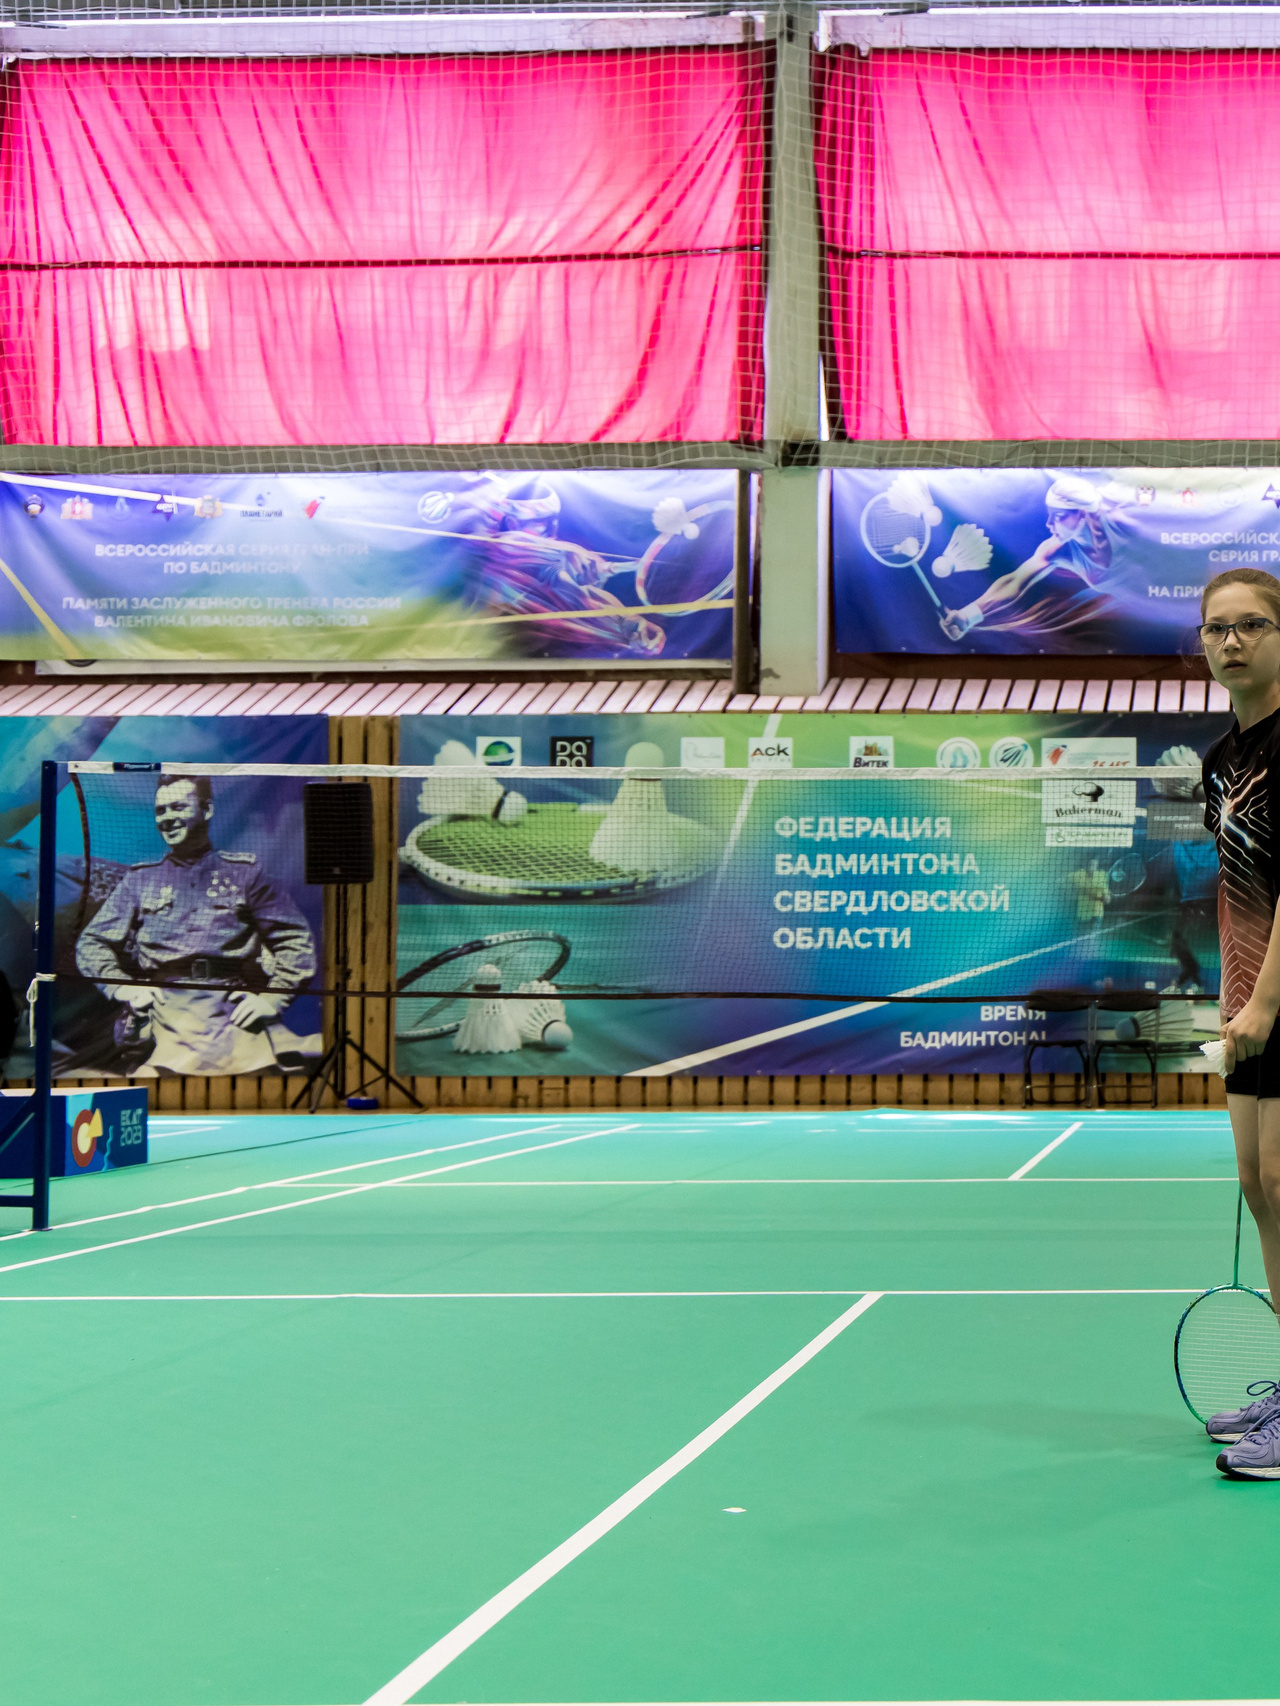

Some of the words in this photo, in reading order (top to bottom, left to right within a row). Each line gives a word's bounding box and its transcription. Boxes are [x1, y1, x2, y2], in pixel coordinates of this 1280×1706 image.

[94, 541, 236, 557] ВСЕРОССИЙСКАЯ
[239, 543, 293, 556] СЕРИЯ
[1208, 549, 1259, 562] СЕРИЯ
[164, 561, 187, 574] ПО
[190, 561, 301, 575] БАДМИНТОНУ
[1148, 585, 1168, 598] НА
[62, 597, 127, 610] ПАМЯТИ
[131, 597, 262, 609] ЗАСЛУЖЕННОГО
[266, 597, 329, 609] ТРЕНЕРА
[332, 597, 401, 609] РОССИИ
[94, 615, 190, 627] ВАЛЕНТИНА
[191, 615, 289, 627] ИВАНОВИЧА
[292, 614, 369, 627] ФРОЛОВА
[774, 815, 951, 842] ФЕДЕРАЦИЯ
[774, 853, 980, 879] БАДМИНТОНА
[773, 884, 1010, 916] СВЕРДЛОВСКОЙ
[773, 927, 911, 950] ОБЛАСТИ
[121, 1125, 142, 1147] 2023
